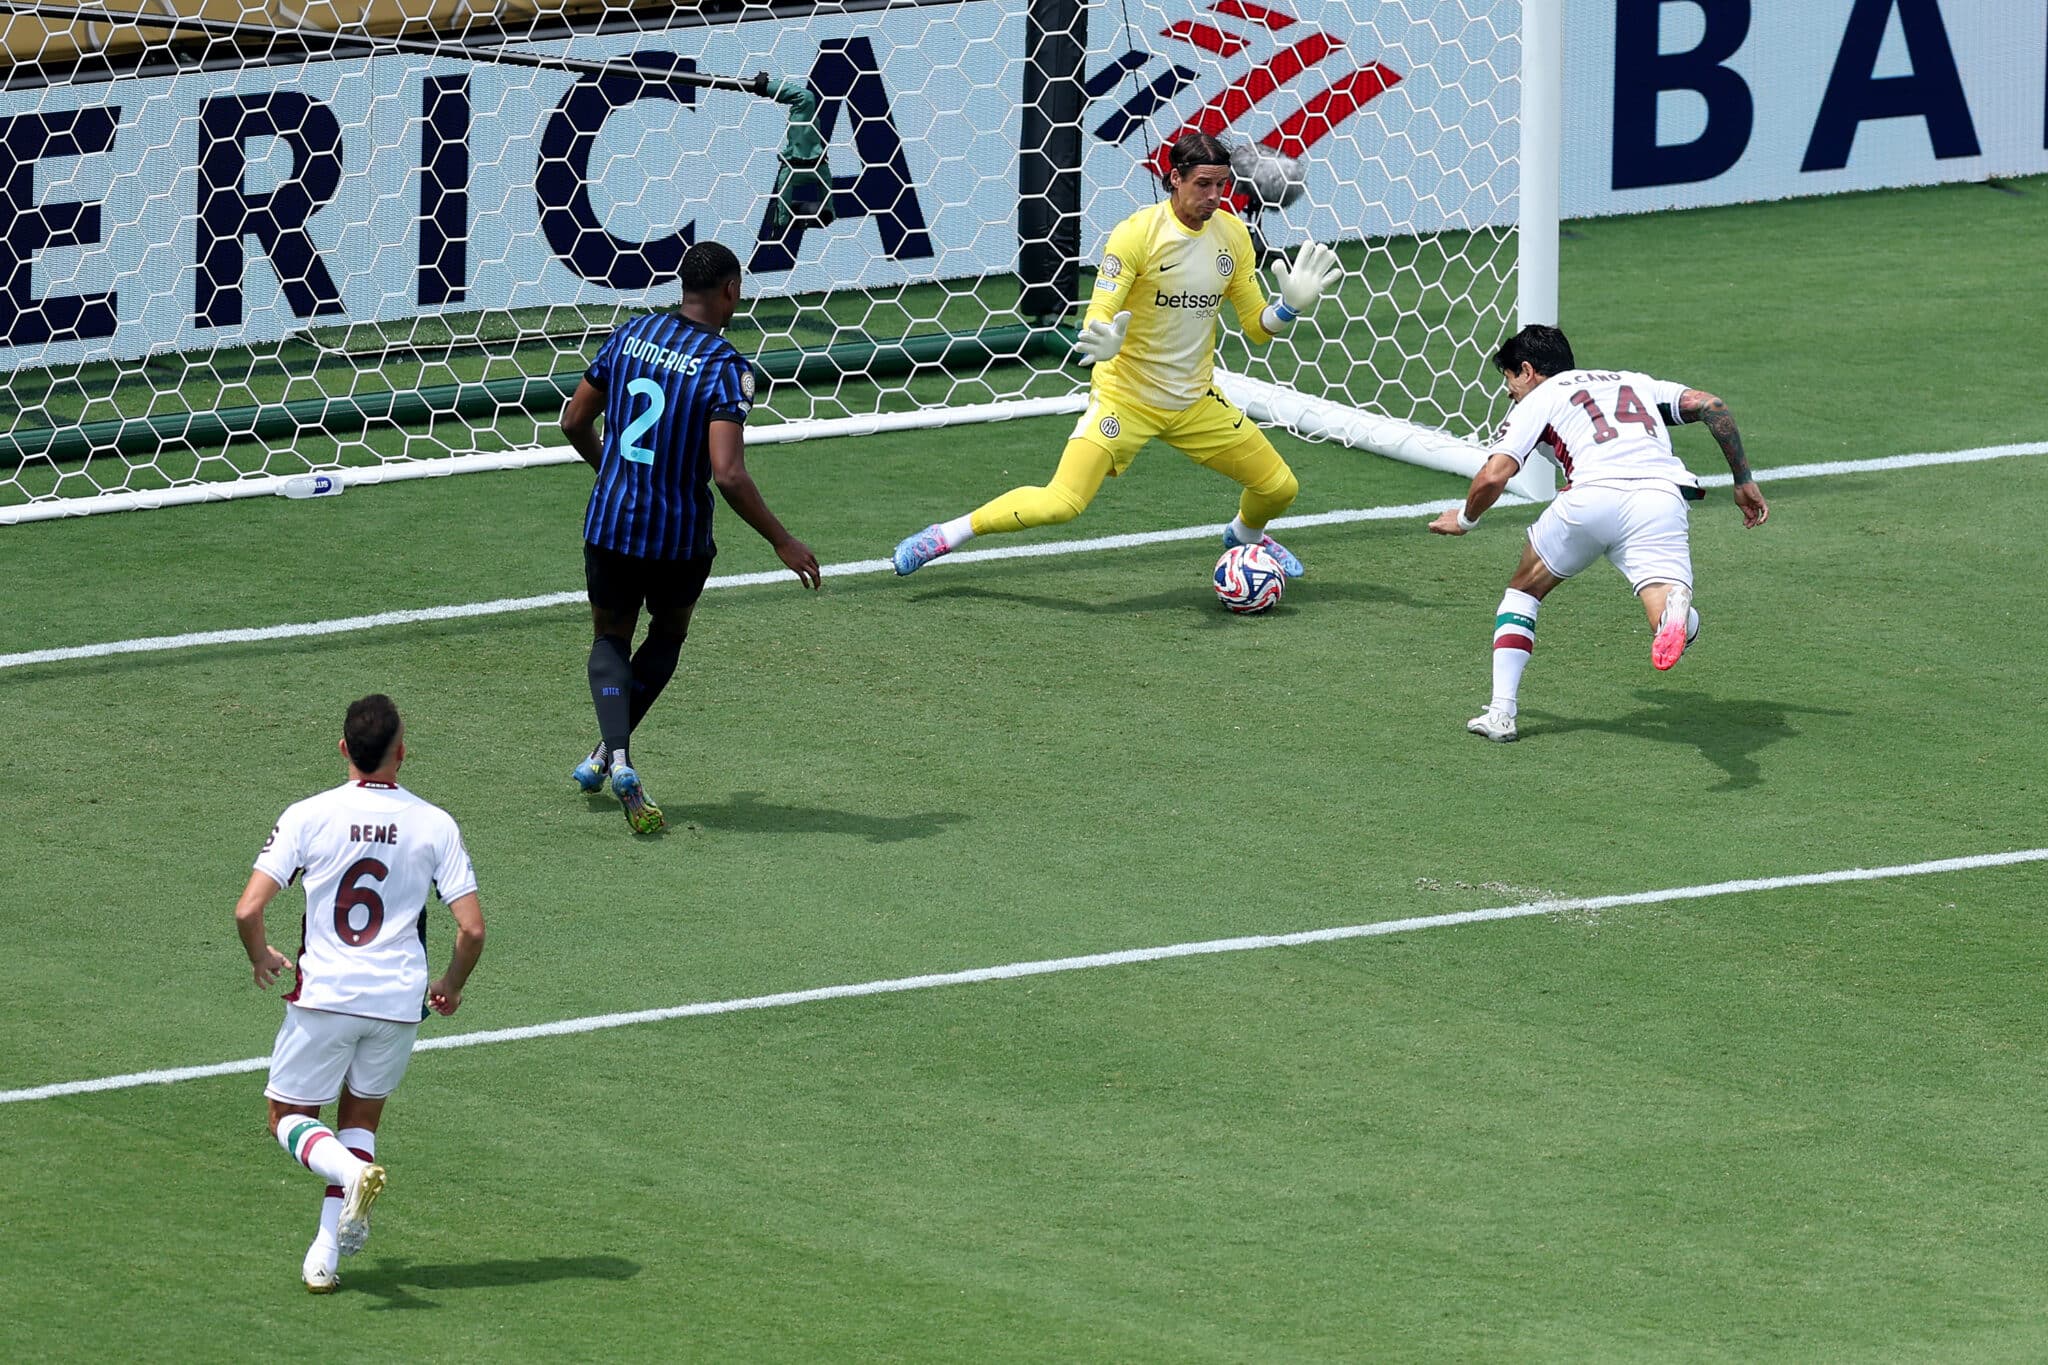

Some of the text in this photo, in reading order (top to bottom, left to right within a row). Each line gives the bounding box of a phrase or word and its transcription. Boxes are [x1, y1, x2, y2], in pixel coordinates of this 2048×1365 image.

[1611, 0, 2048, 190] BA
[0, 36, 935, 348] ERICA
[622, 336, 702, 376] DUMFRIES
[620, 377, 665, 465] 2
[1570, 385, 1658, 444] 14
[350, 823, 398, 845] RENÊ
[333, 857, 389, 947] 6
